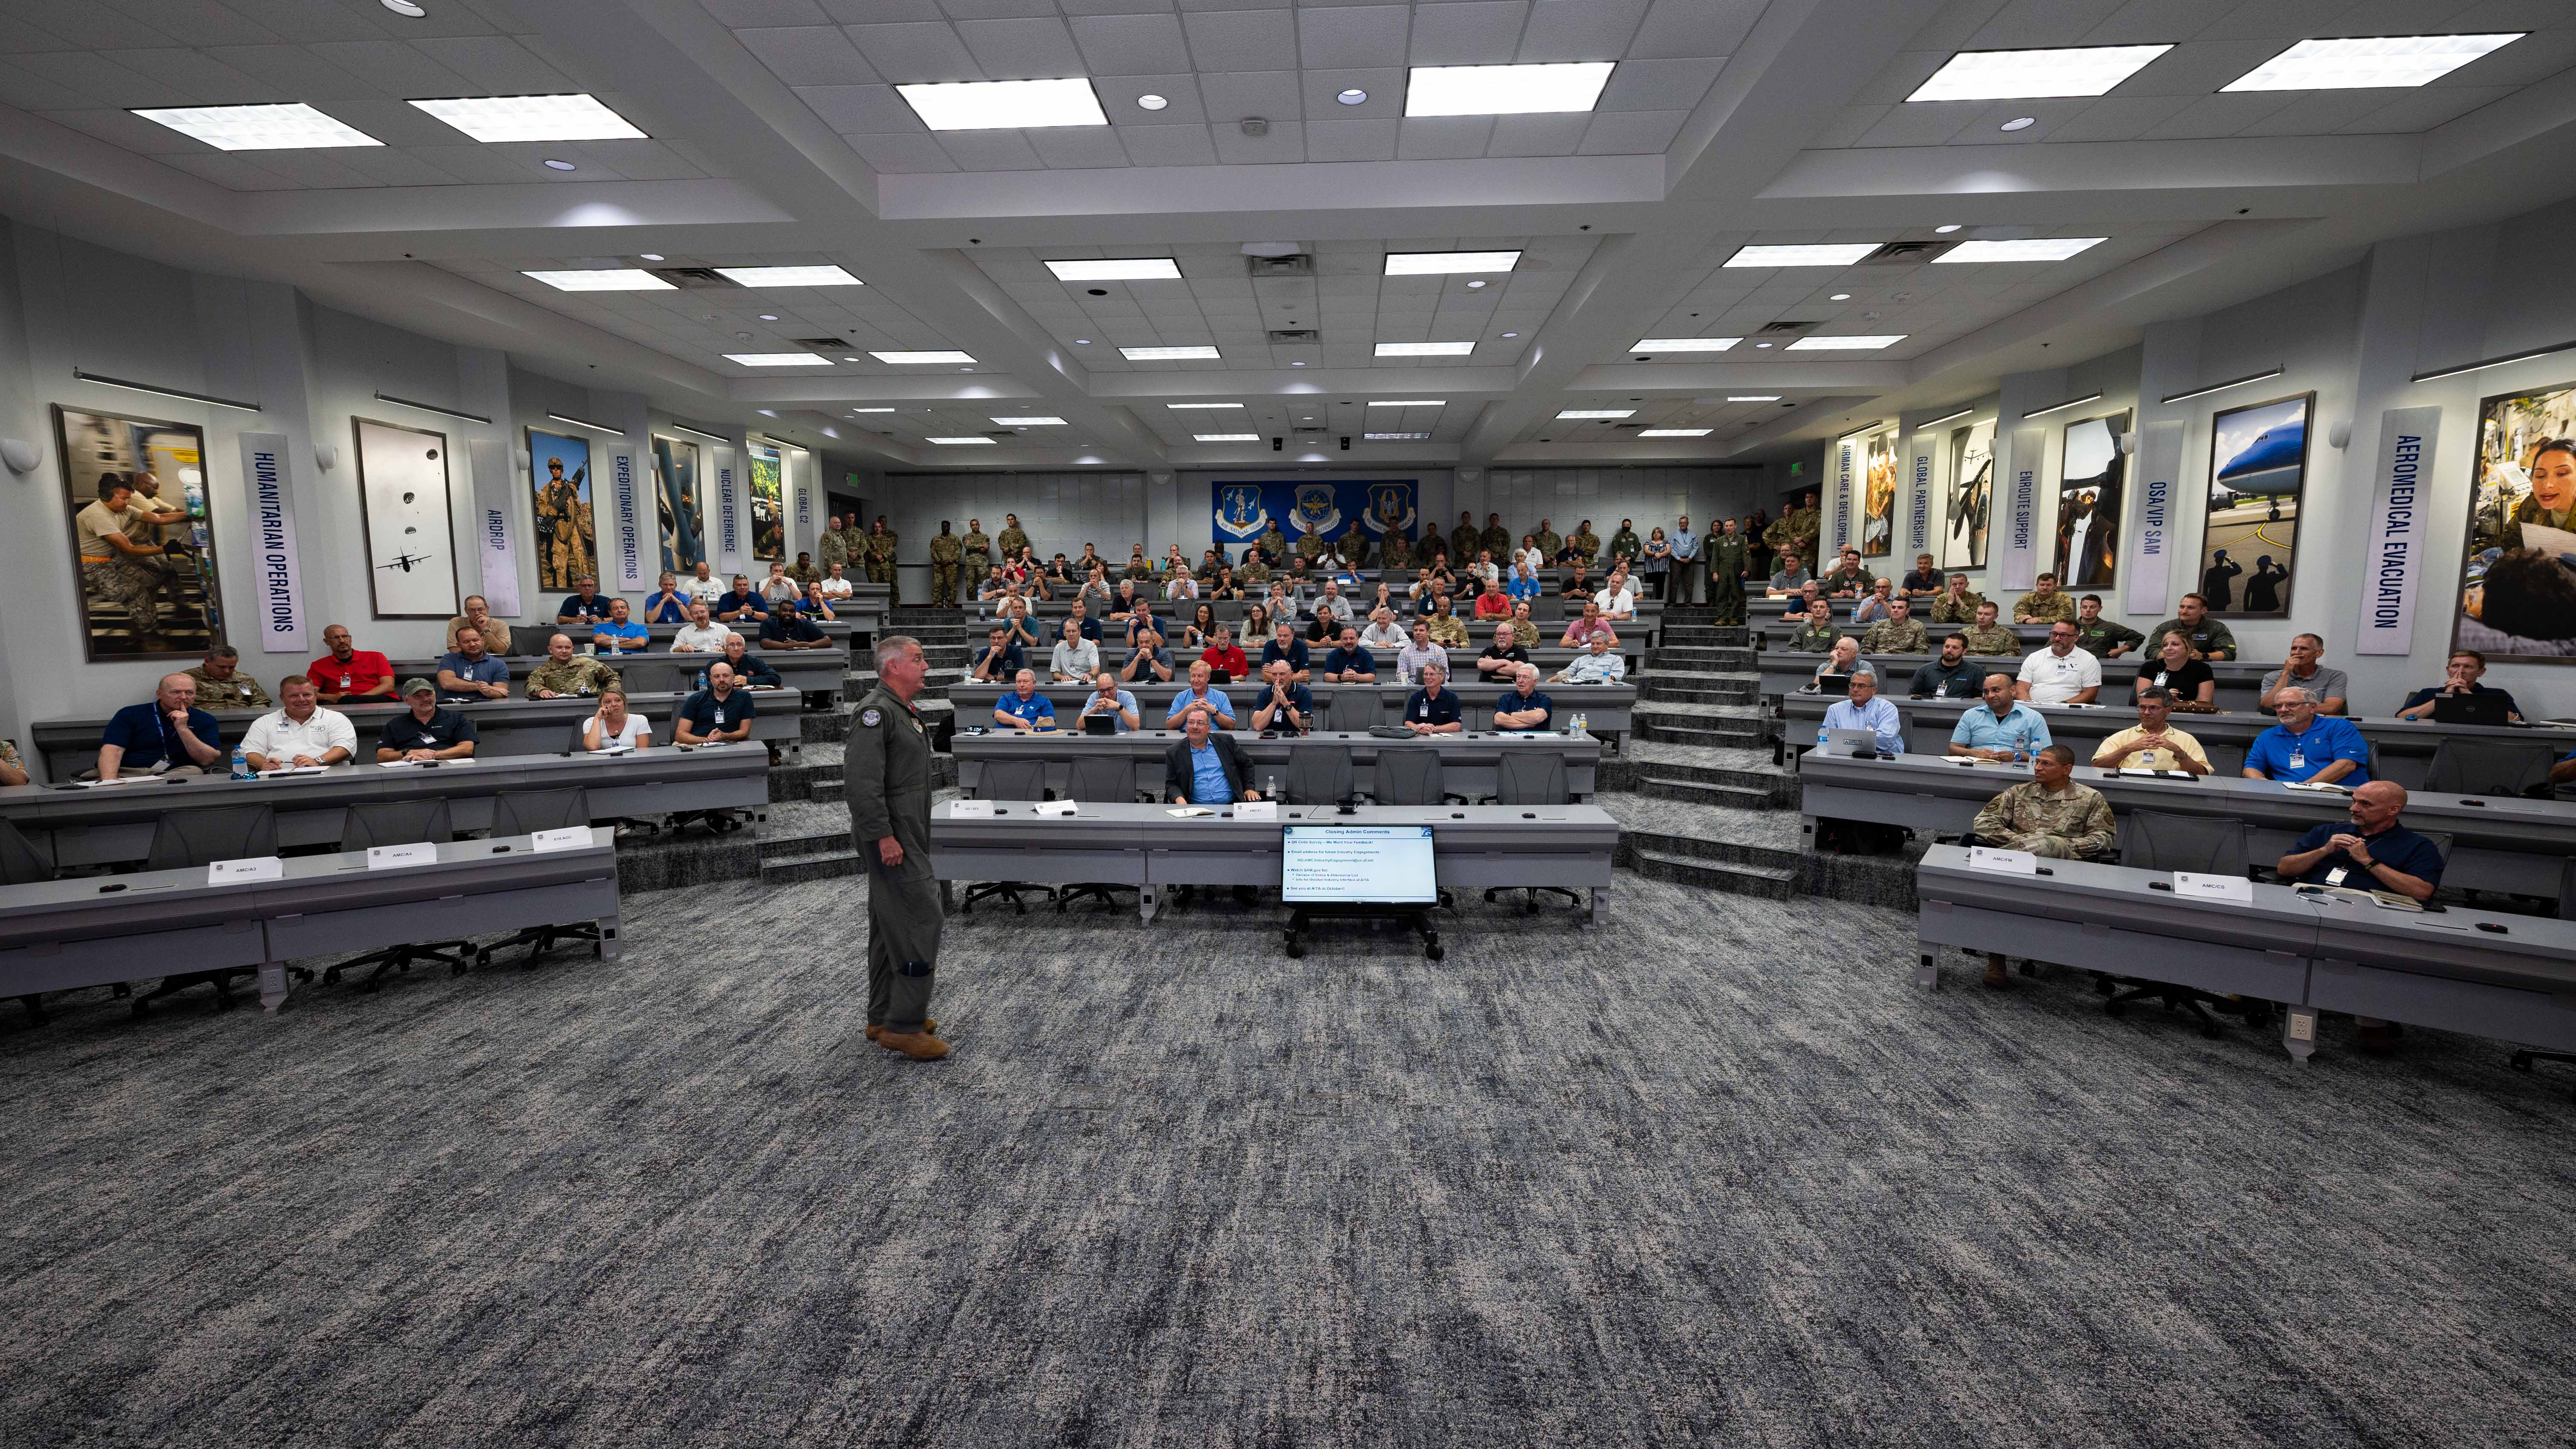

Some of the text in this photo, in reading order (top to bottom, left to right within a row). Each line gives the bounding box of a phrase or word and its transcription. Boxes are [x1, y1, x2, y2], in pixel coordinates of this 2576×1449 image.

[1840, 474, 1849, 492] CARE
[1841, 445, 1851, 472] AIRMAN
[488, 509, 505, 550] AIRDROP
[616, 456, 637, 579] EXPEDITIONARY OPERATIONS
[721, 469, 735, 552] NUCLEAR DETERRENCE
[798, 488, 808, 523] GLOBAL C2
[1229, 526, 1248, 536] NATIONAL
[1250, 521, 1262, 531] GUARD
[1318, 518, 1337, 533] COMMAND
[1912, 456, 1928, 549] GLOBAL PARTNERSHIPS
[2014, 471, 2033, 549] ENROUTE SUPPORT
[2144, 482, 2167, 554] OSA/VIP SAM
[2374, 436, 2421, 628] AEROMEDICAL EVACUATION
[254, 452, 293, 632] HUMANITARIAN OPERATIONS
